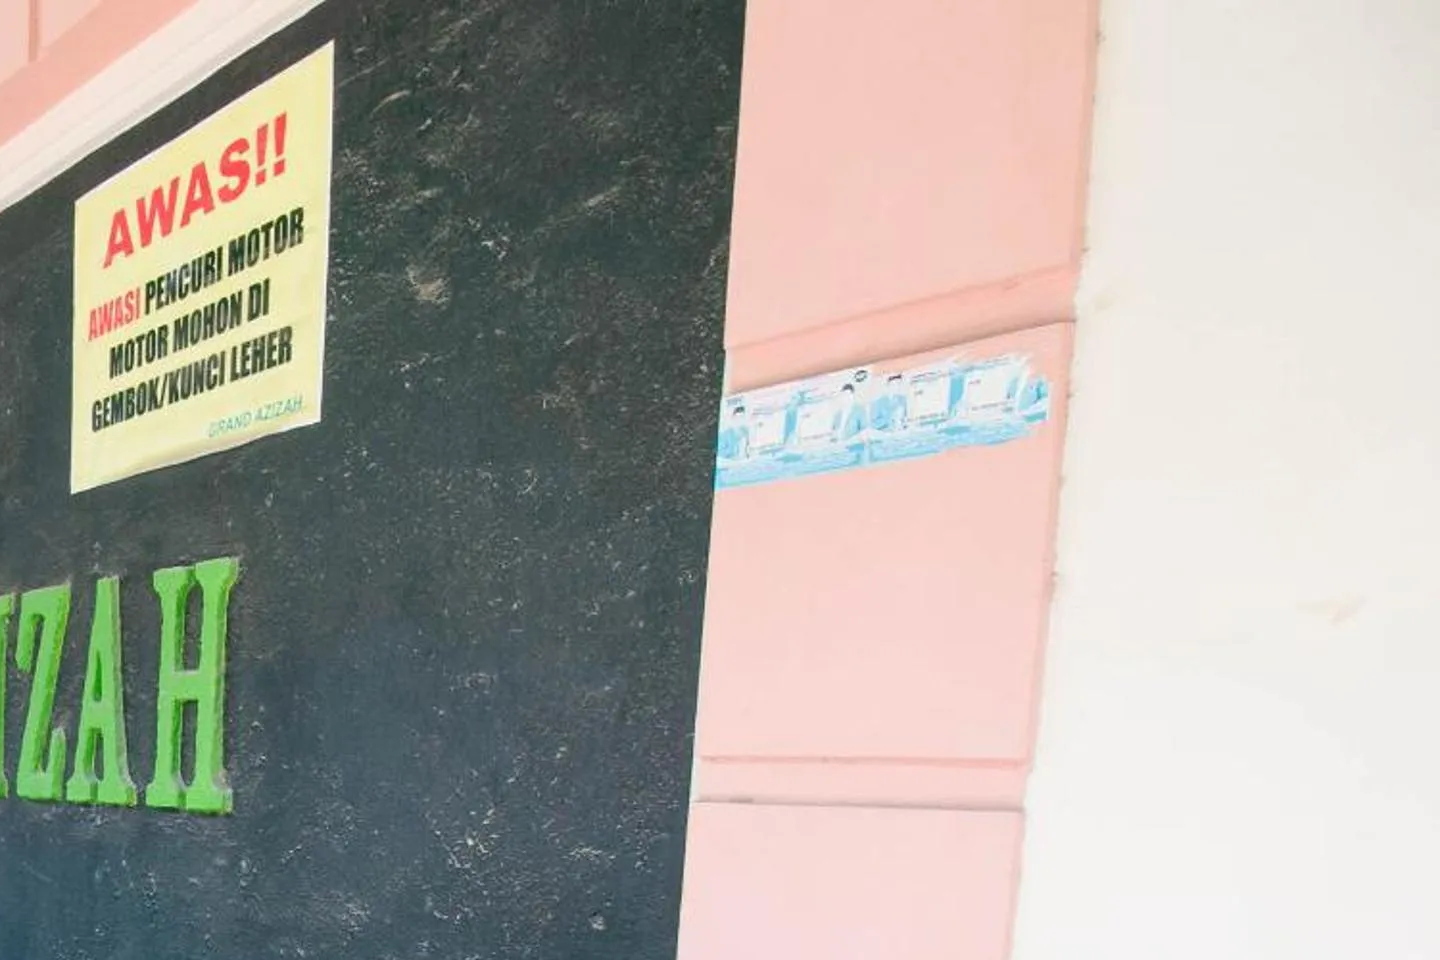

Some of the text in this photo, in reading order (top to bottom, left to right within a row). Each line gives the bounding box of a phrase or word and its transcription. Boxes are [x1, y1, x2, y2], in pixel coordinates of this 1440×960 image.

[102, 111, 288, 269] AWAS!!
[143, 246, 224, 316] PENCURI
[227, 206, 305, 277] MOTOR
[91, 325, 294, 433] GEMBOK/KUNCI LEHER
[109, 278, 271, 380] MOTOR MOHON DI
[208, 394, 303, 438] GRAND AZIZAH
